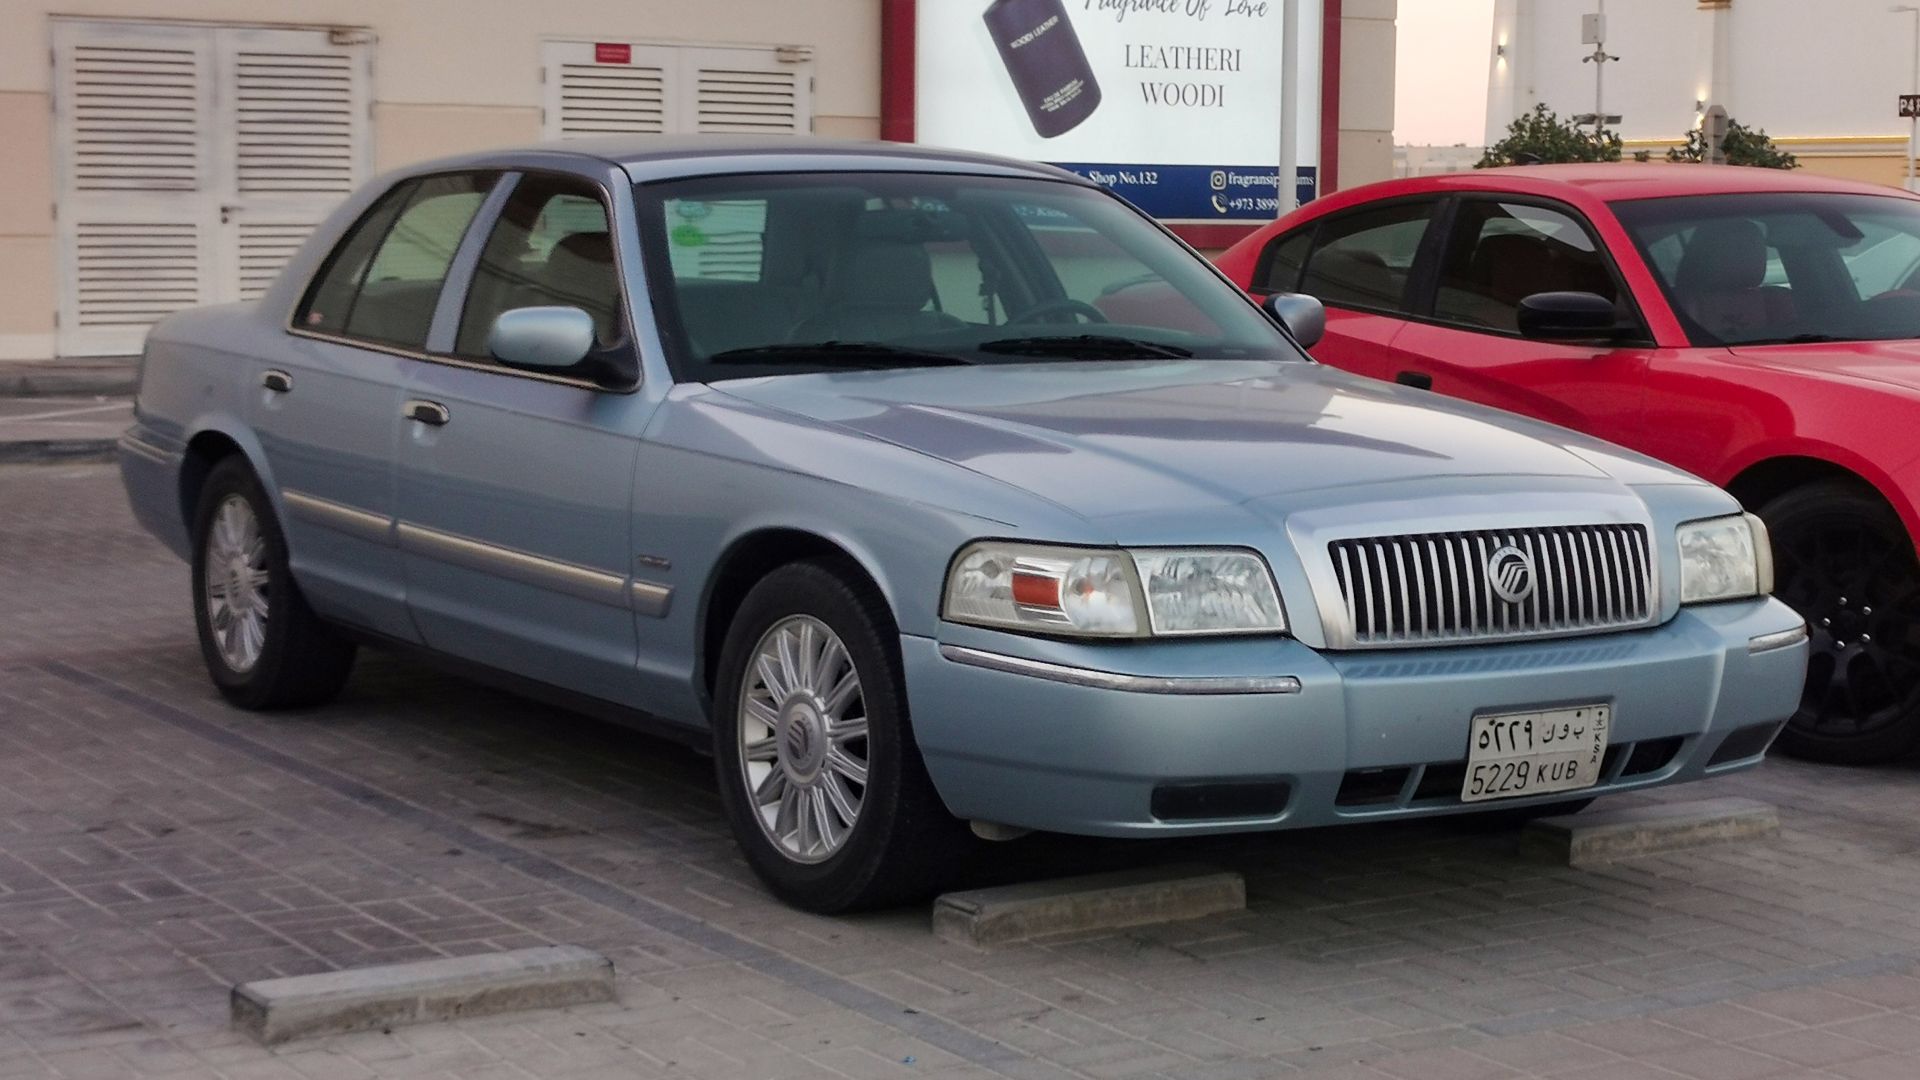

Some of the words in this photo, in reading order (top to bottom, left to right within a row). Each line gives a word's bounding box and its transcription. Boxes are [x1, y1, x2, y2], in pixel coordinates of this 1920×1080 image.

[1125, 44, 1242, 72] LEATHERI
[1141, 82, 1224, 107] WOODI
[1089, 170, 1117, 187] Shop
[1119, 171, 1158, 185] No.132
[1229, 198, 1253, 210] +973
[1471, 760, 1530, 795] 5229
[1535, 760, 1578, 784] KUB
